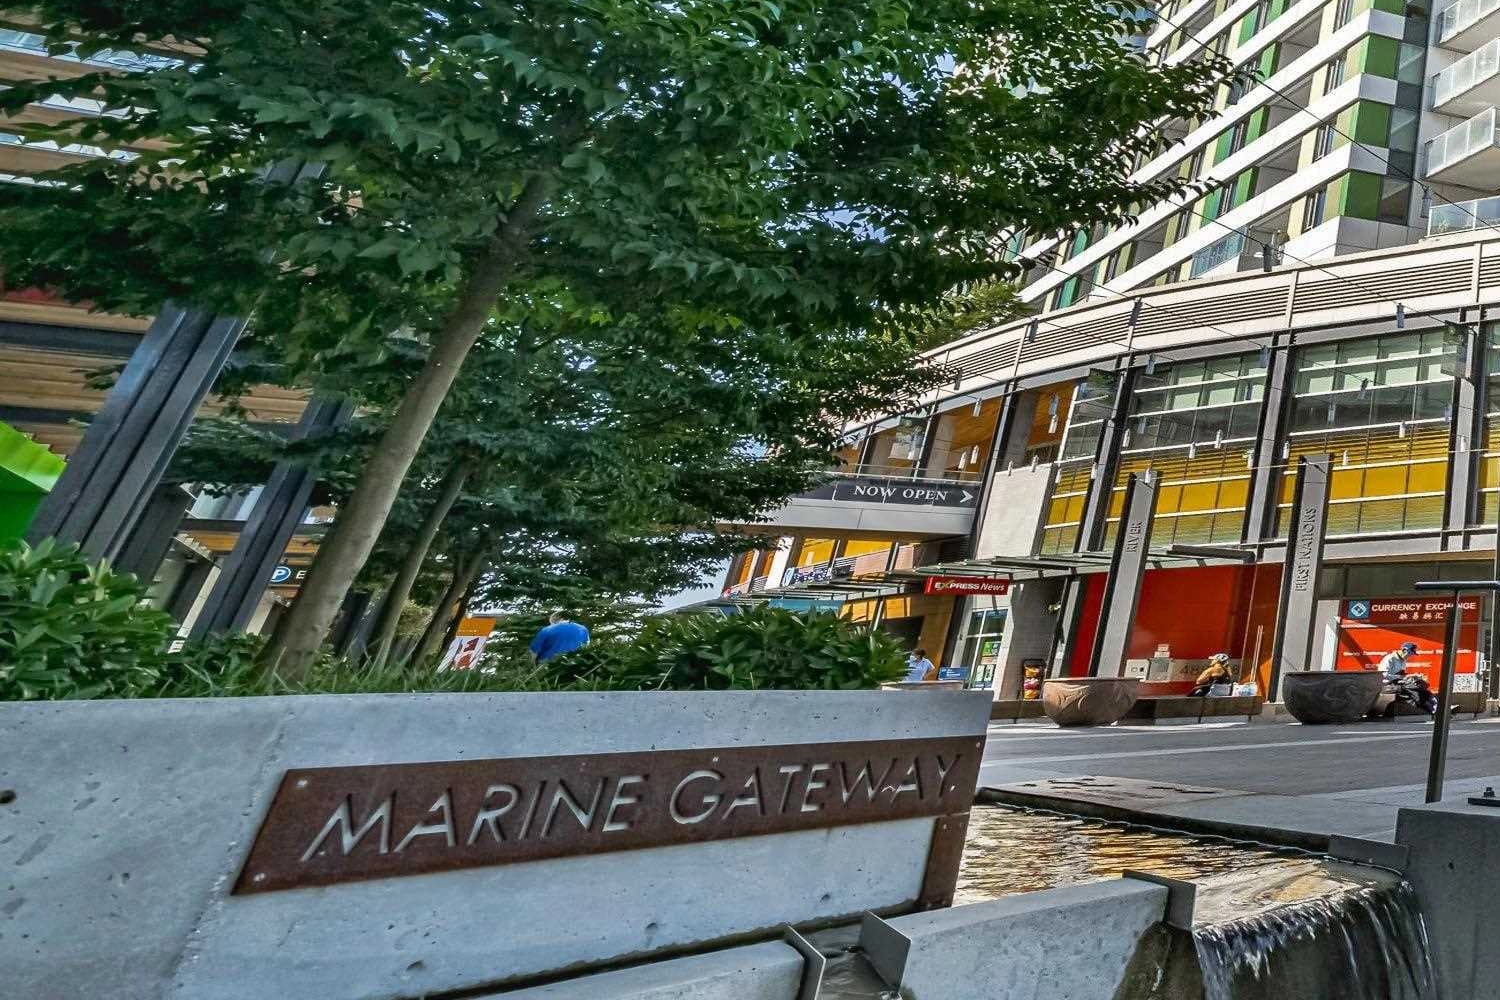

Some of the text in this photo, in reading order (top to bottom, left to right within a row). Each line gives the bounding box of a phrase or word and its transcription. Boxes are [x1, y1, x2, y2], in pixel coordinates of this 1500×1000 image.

[854, 485, 948, 500] NOW OPEN
[1126, 521, 1142, 553] RIVER
[1295, 507, 1317, 591] FIRST NATIONS
[934, 580, 1005, 591] EXPRESS News
[1371, 602, 1477, 611] CURRENCY EXCHNGE
[301, 753, 962, 862] MARINE GATEWAY
